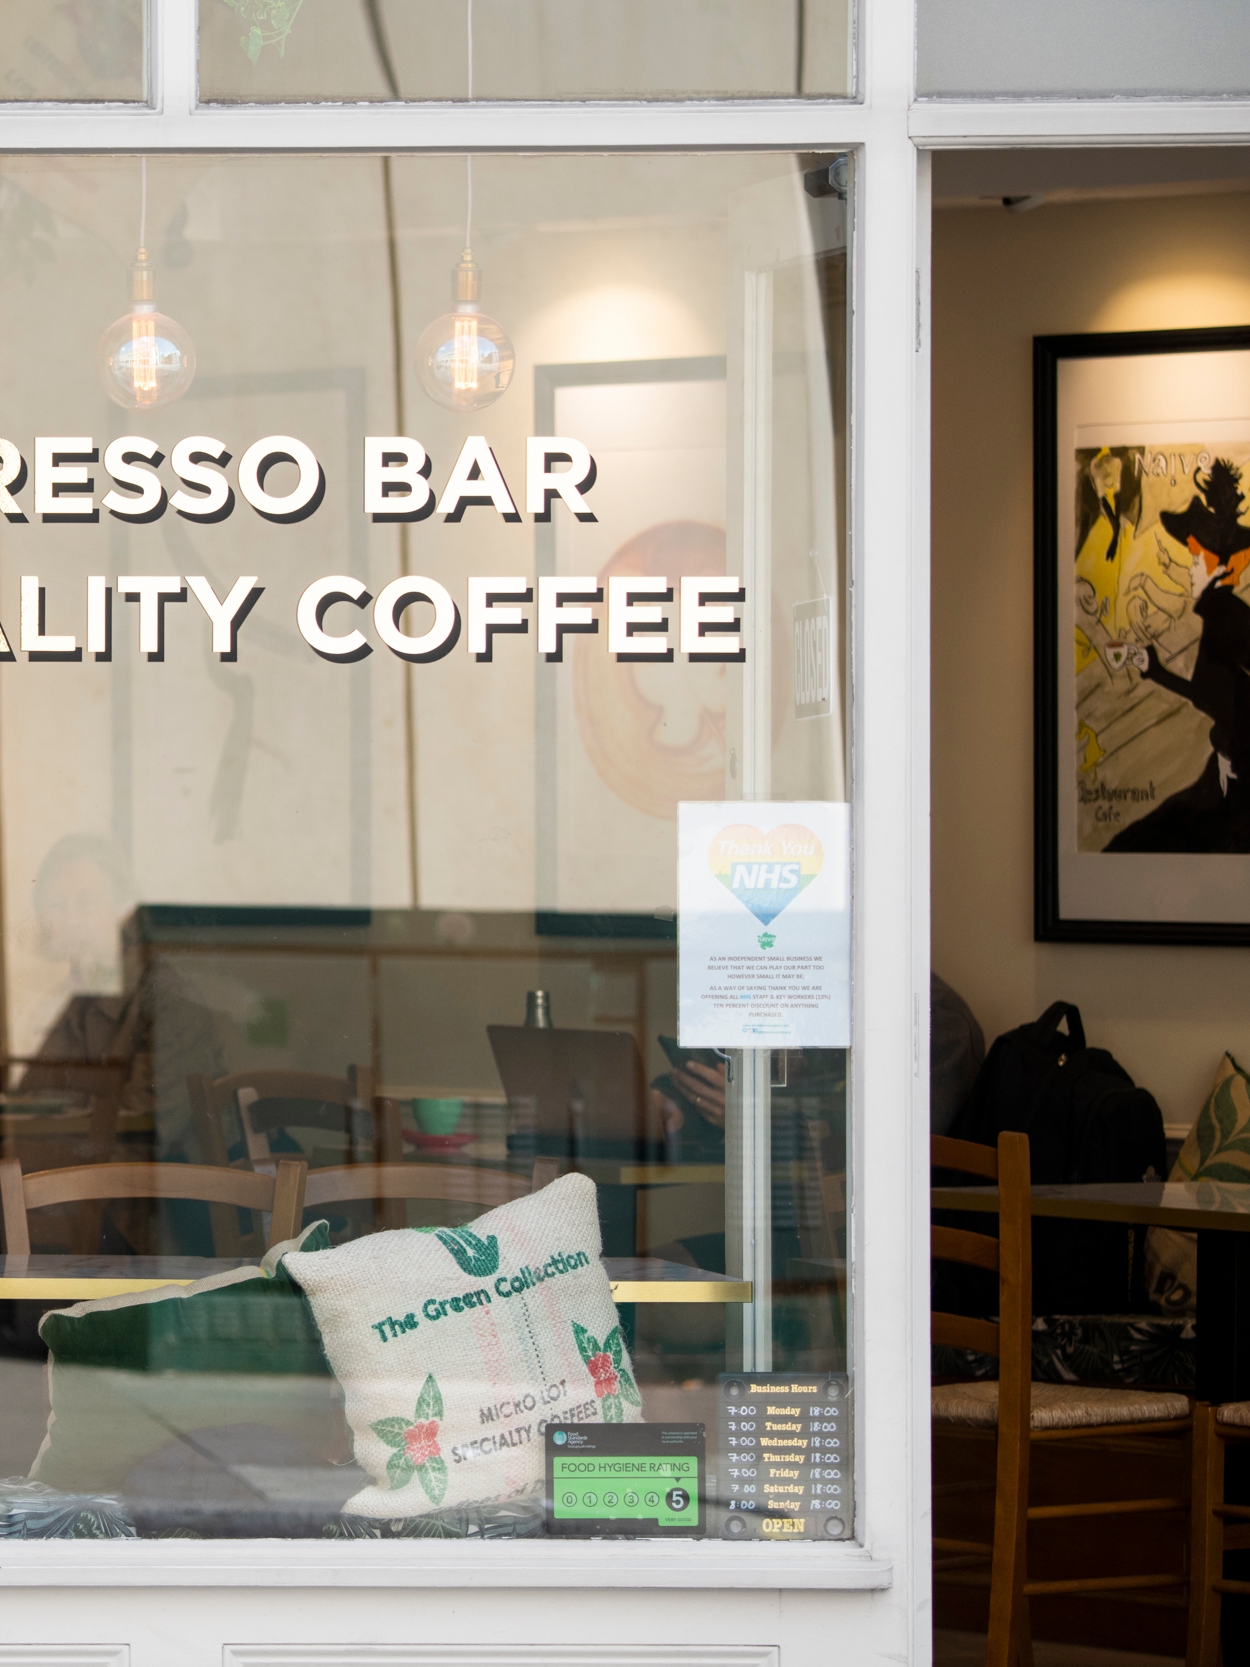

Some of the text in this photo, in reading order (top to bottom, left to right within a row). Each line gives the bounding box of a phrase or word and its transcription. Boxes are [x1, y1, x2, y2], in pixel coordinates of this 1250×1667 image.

[364, 435, 598, 523] BAR
[296, 574, 747, 663] COFFEE
[794, 615, 829, 706] CLOSED
[718, 840, 816, 856] Thank You
[732, 864, 799, 889] NHS
[371, 1250, 590, 1343] The Green Collection
[750, 1384, 818, 1393] Business Hours
[479, 1379, 569, 1425] MICRO LOT
[766, 1406, 801, 1416] Monday
[809, 1406, 839, 1416] 18:00
[765, 1422, 802, 1432] Tuesday
[809, 1422, 837, 1431] 18:00
[451, 1425, 532, 1464] SPECIALTY
[760, 1438, 808, 1448] Wednesday
[811, 1437, 840, 1447] 18:00
[763, 1453, 805, 1463] Thursday
[811, 1453, 840, 1463] 18:00
[561, 1462, 690, 1472] FOOD HYGIENE RATING
[769, 1469, 799, 1479] Friday
[810, 1468, 841, 1479] 18:00
[764, 1484, 804, 1495] Saturday
[811, 1483, 841, 1494] 18:00
[566, 1495, 573, 1504] 0
[607, 1495, 614, 1504] 2
[628, 1495, 635, 1504] 3
[648, 1495, 655, 1504] 4
[671, 1491, 684, 1509] 5
[729, 1500, 841, 1510] 8:00 Sunday 18:00
[762, 1519, 805, 1532] OPEN
